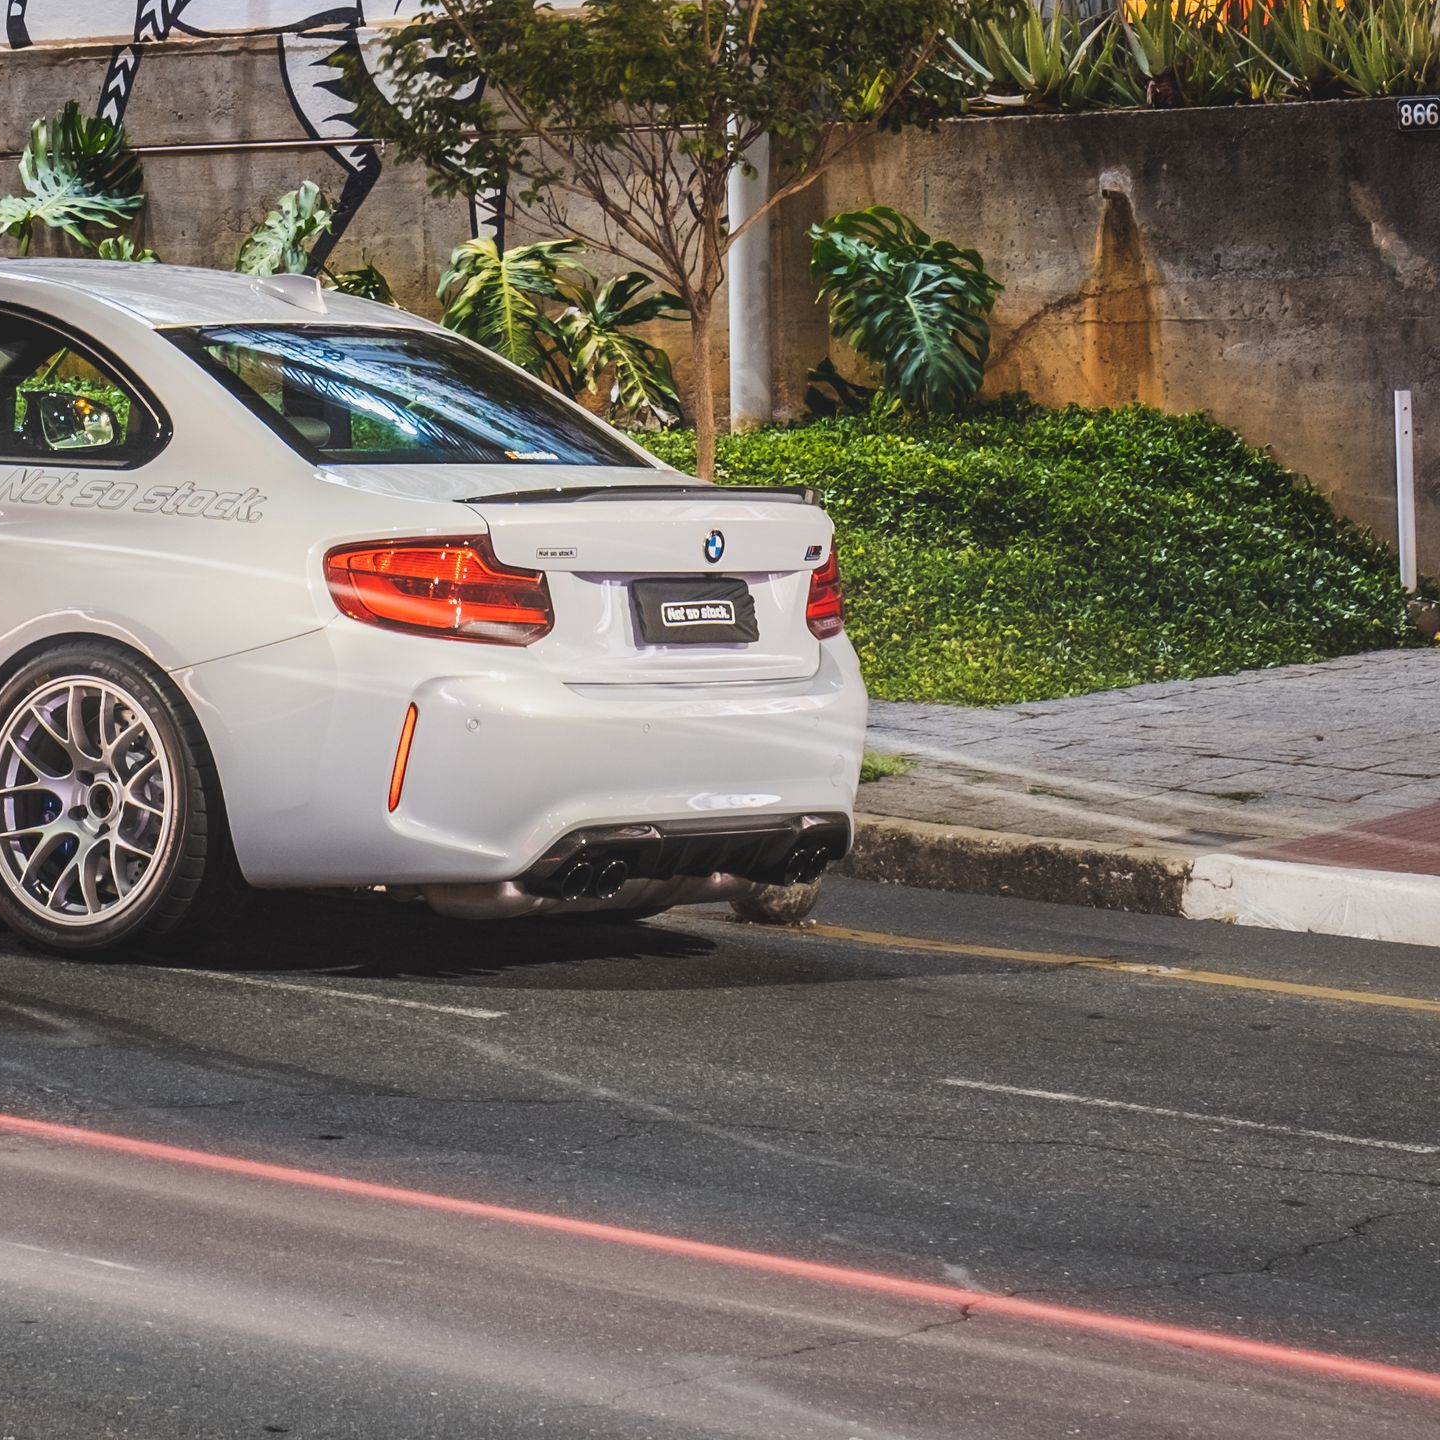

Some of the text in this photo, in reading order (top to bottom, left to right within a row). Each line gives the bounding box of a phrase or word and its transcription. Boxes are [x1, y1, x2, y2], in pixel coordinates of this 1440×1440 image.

[1400, 103, 1439, 126] 866
[70, 479, 139, 510] so
[133, 481, 268, 523] stock.
[667, 606, 685, 621] Not
[686, 608, 700, 620] so
